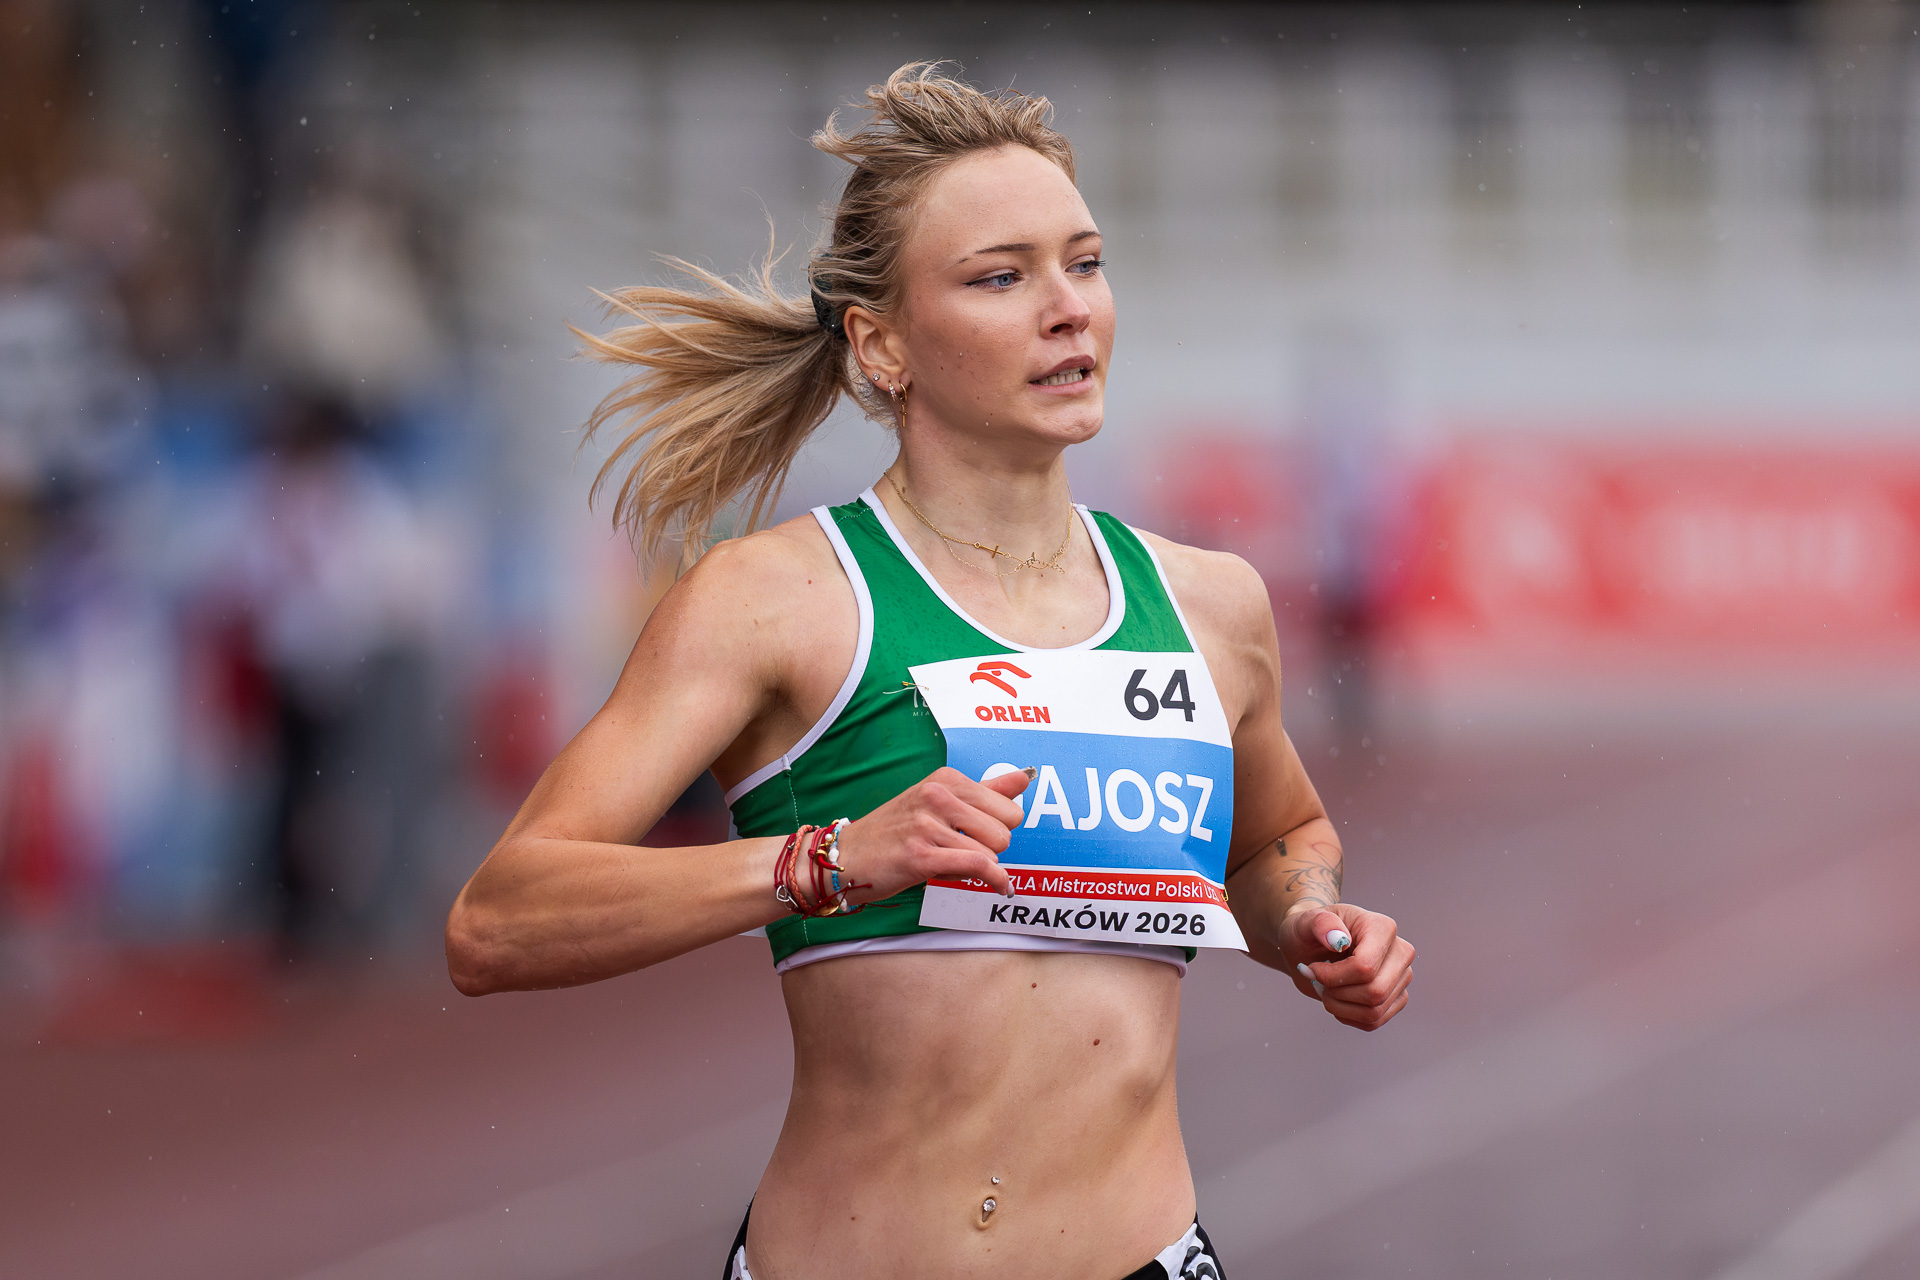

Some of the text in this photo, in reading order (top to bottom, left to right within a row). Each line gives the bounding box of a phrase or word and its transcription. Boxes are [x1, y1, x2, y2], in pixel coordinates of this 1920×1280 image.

[1123, 668, 1196, 723] 64
[974, 705, 1051, 724] ORLEN
[1041, 876, 1151, 897] Mistrzostwa
[1155, 881, 1203, 898] Polski
[988, 903, 1206, 936] KRAKÓW 2026
